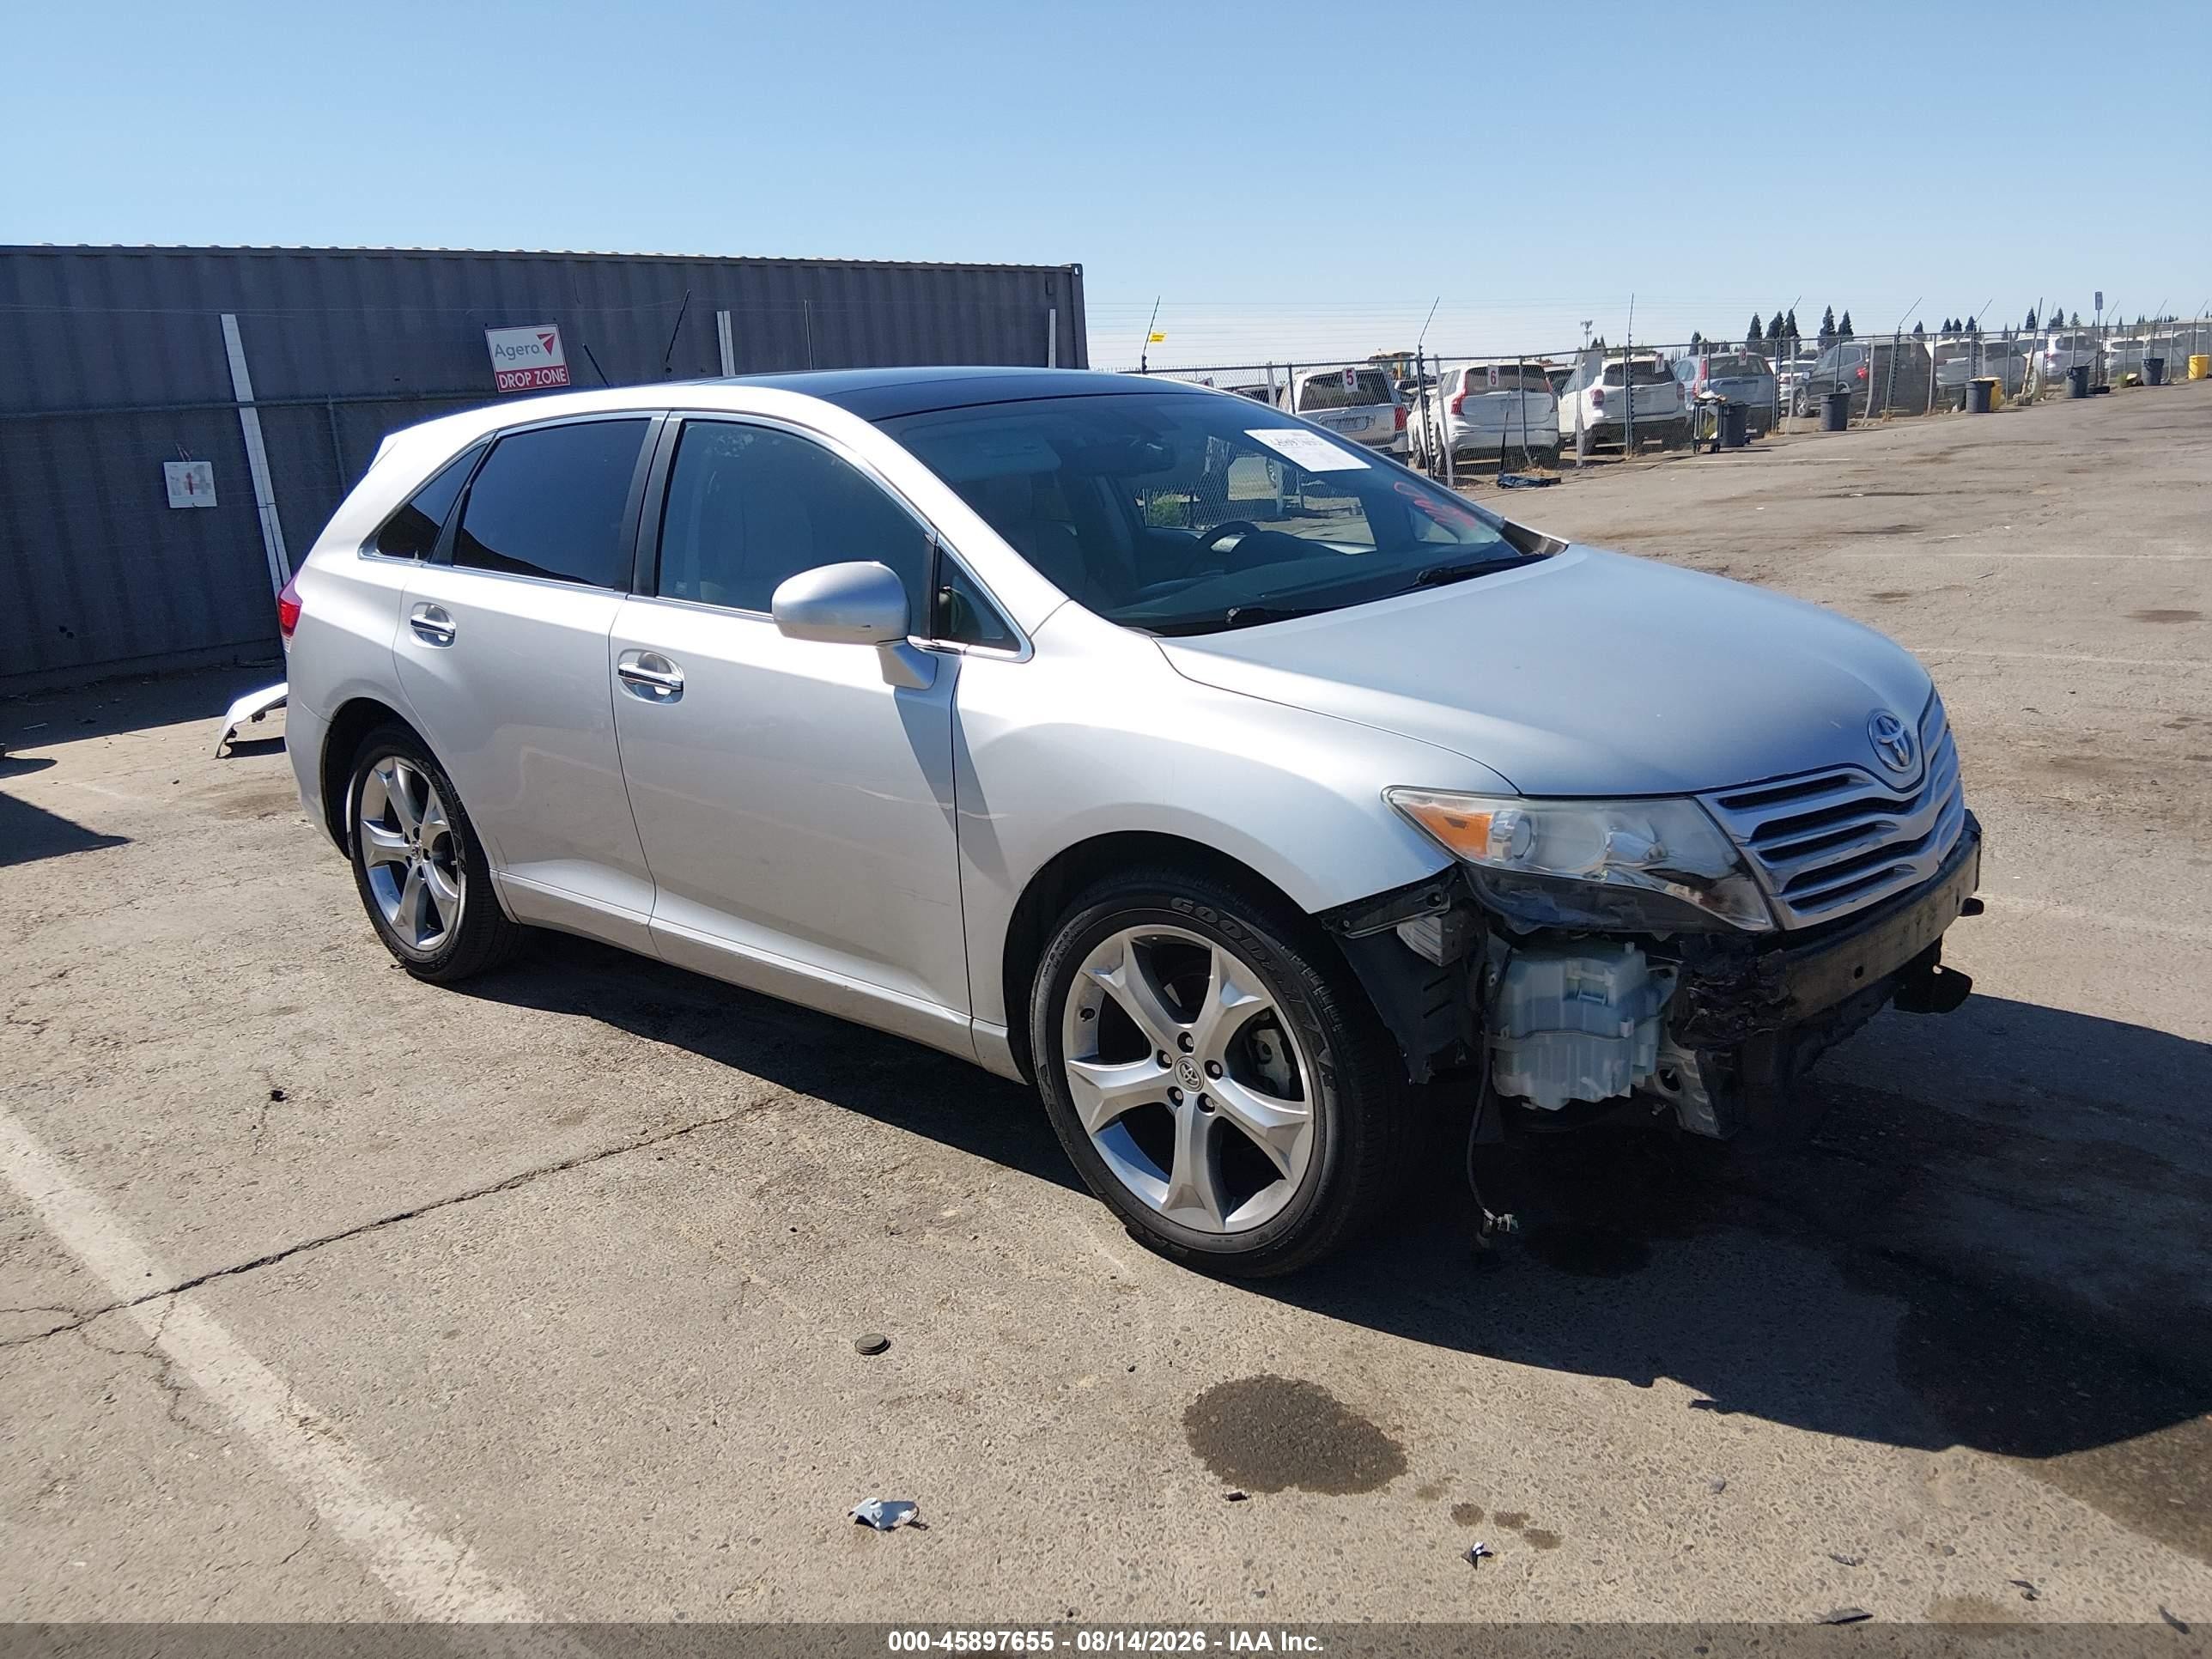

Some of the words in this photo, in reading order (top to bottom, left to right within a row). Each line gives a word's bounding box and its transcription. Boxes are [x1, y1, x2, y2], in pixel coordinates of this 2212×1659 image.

[495, 343, 540, 361] Agero
[1657, 353, 1663, 368] 7
[499, 372, 532, 389] DROP
[534, 368, 567, 385] ZONE
[1346, 369, 1354, 386] 5
[1490, 370, 1497, 386] 6
